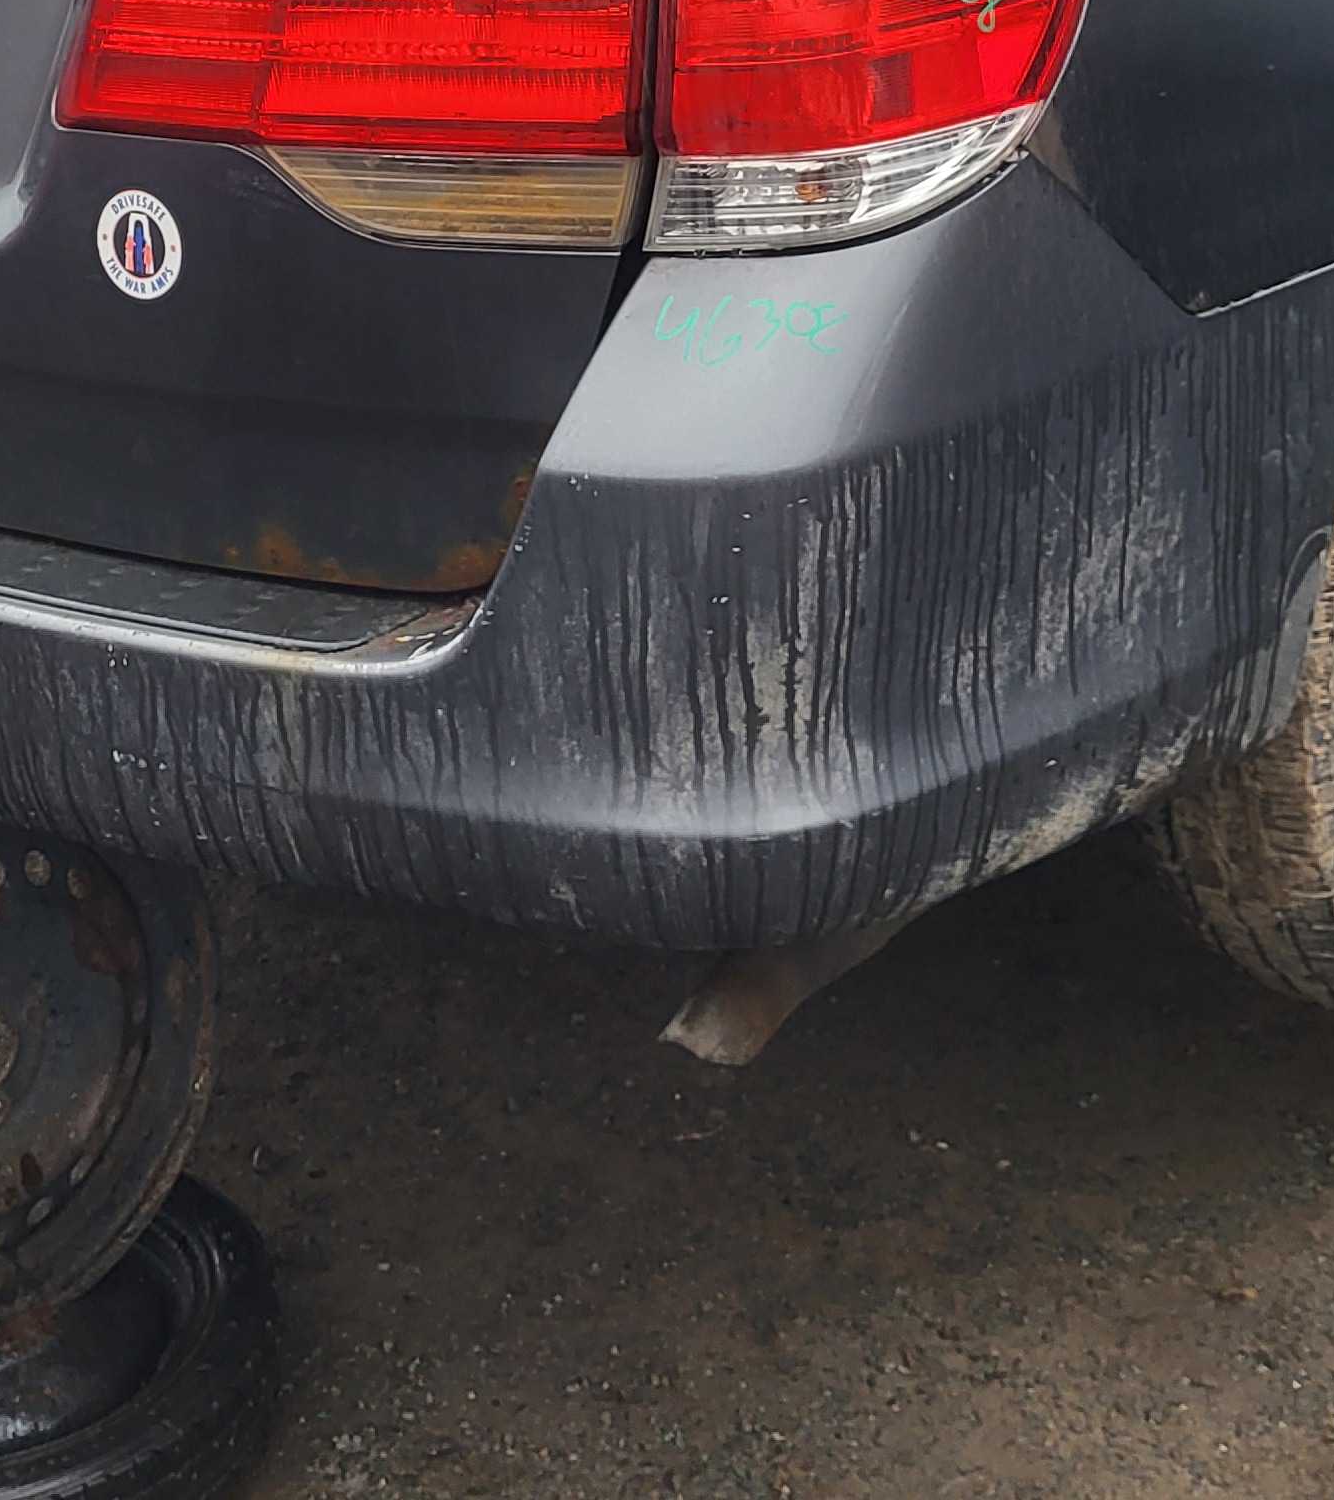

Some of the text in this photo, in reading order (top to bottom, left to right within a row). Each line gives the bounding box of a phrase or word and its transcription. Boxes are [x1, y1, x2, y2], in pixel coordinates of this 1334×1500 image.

[110, 194, 167, 223] DRIVESAFE
[106, 257, 175, 295] THE WAR AMPS
